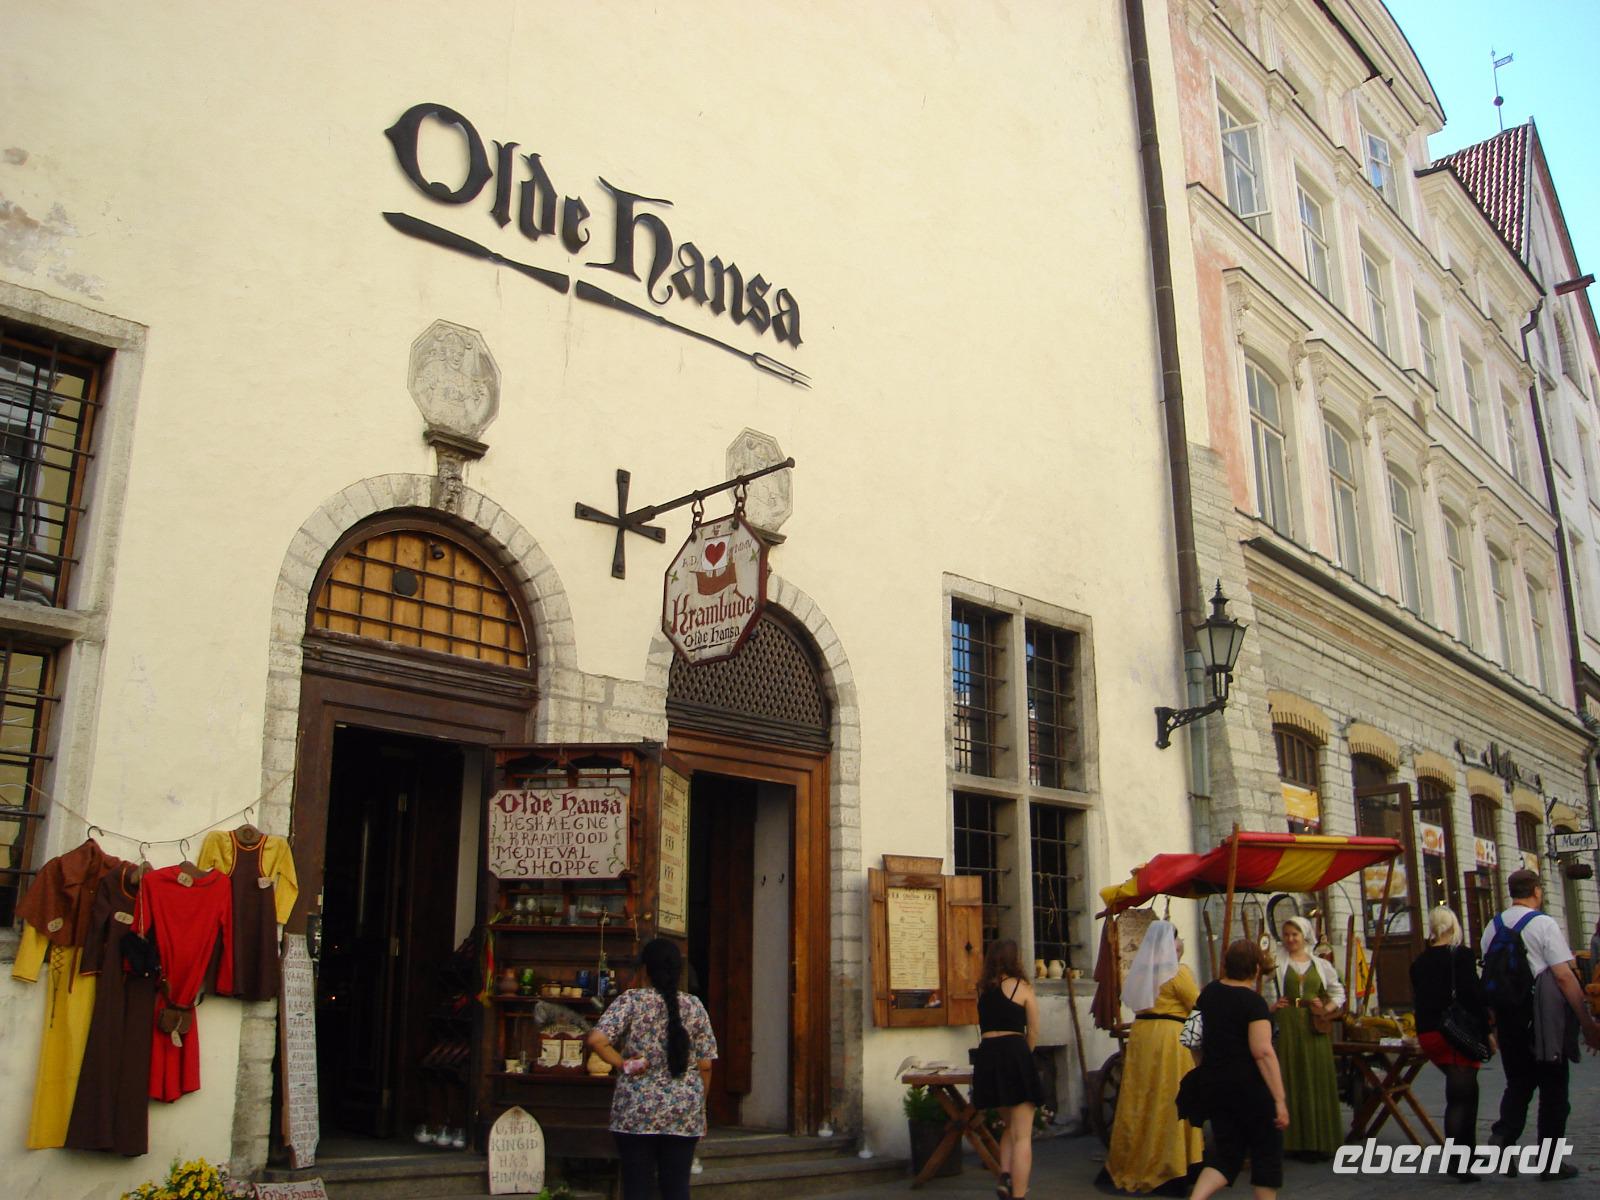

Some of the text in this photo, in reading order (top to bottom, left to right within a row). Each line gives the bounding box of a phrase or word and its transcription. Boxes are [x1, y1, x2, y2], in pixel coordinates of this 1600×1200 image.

[384, 102, 804, 349] Olde Hansa
[684, 631, 708, 648] Olde
[496, 791, 622, 818] Olde Hansa
[510, 831, 608, 846] KRAAMIPOOD
[496, 845, 591, 860] MEDIEVAL
[517, 860, 600, 876] SHOPPE
